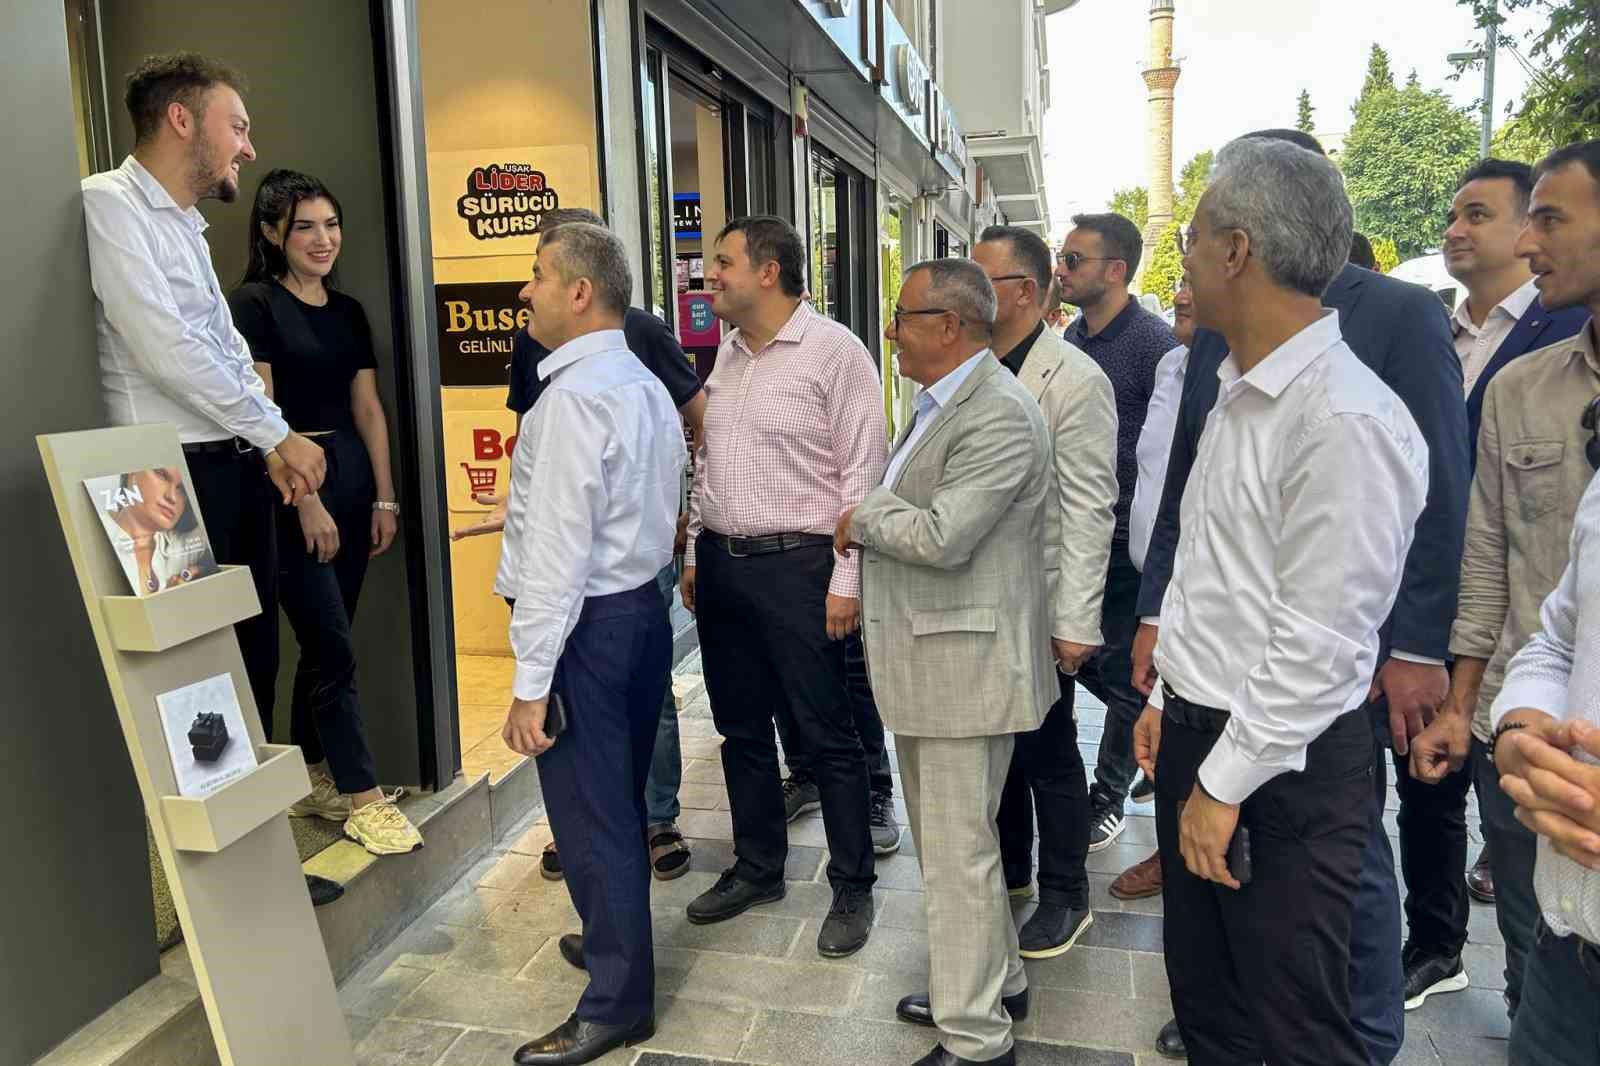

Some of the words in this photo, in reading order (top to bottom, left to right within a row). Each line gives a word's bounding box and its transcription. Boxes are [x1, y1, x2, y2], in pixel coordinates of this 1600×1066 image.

[475, 168, 542, 191] LİDER
[463, 192, 555, 216] SÜRÜCÜ
[459, 337, 513, 354] GELİNLİ
